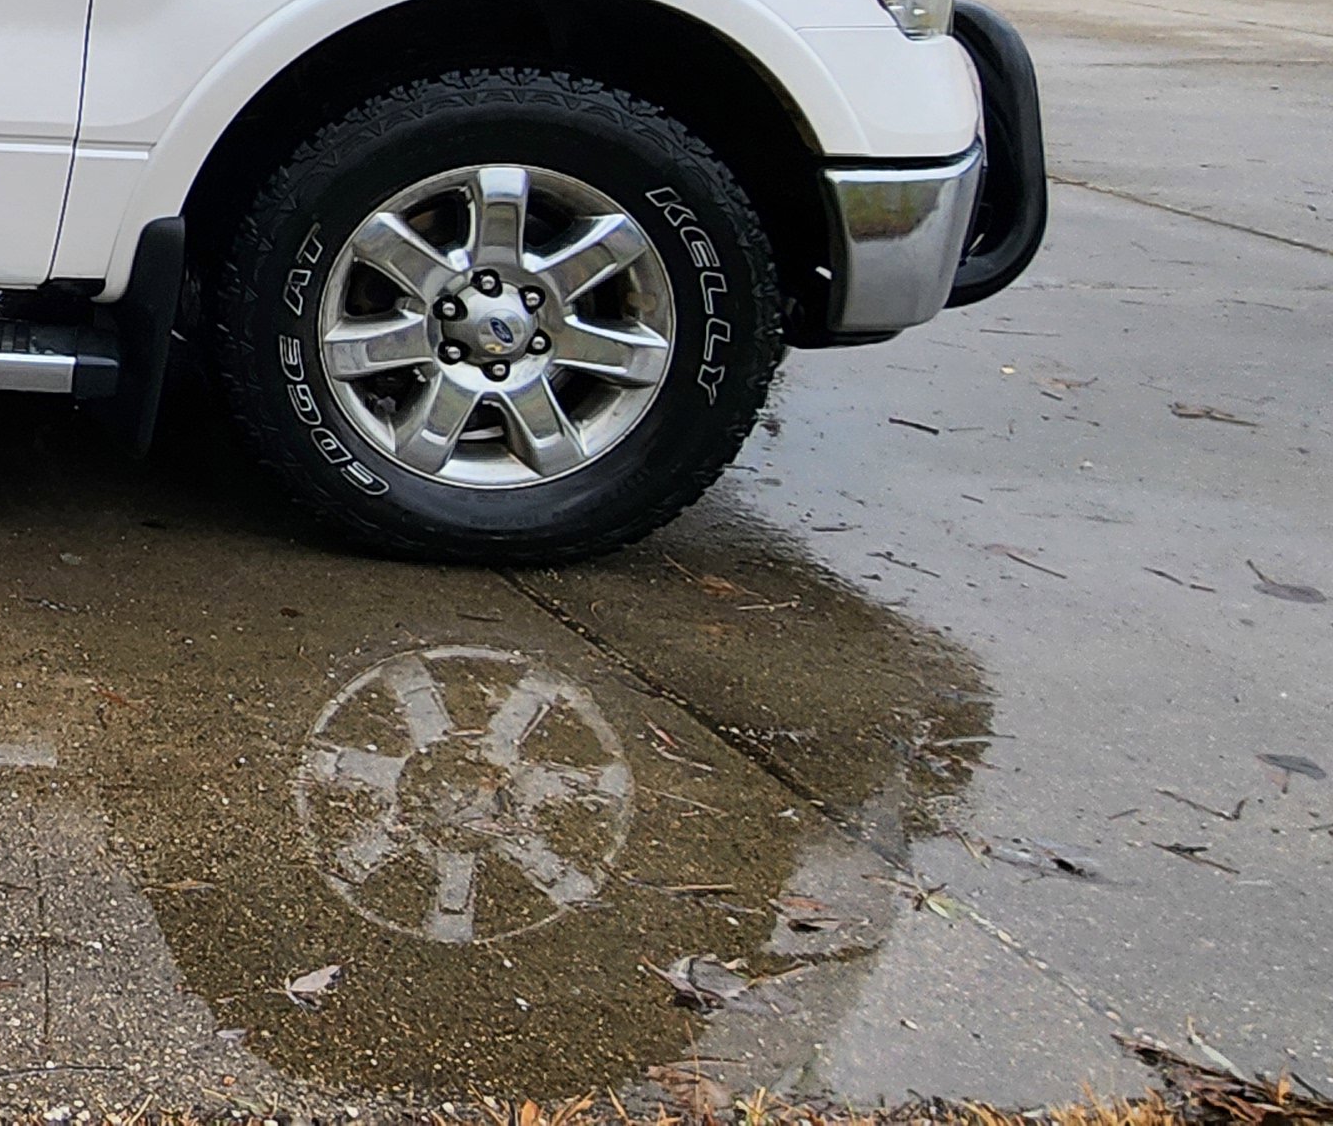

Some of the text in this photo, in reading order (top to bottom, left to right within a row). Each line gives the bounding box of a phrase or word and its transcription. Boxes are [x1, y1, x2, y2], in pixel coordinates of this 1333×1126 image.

[279, 221, 390, 496] EDGE AT
[645, 186, 731, 406] KELLY
